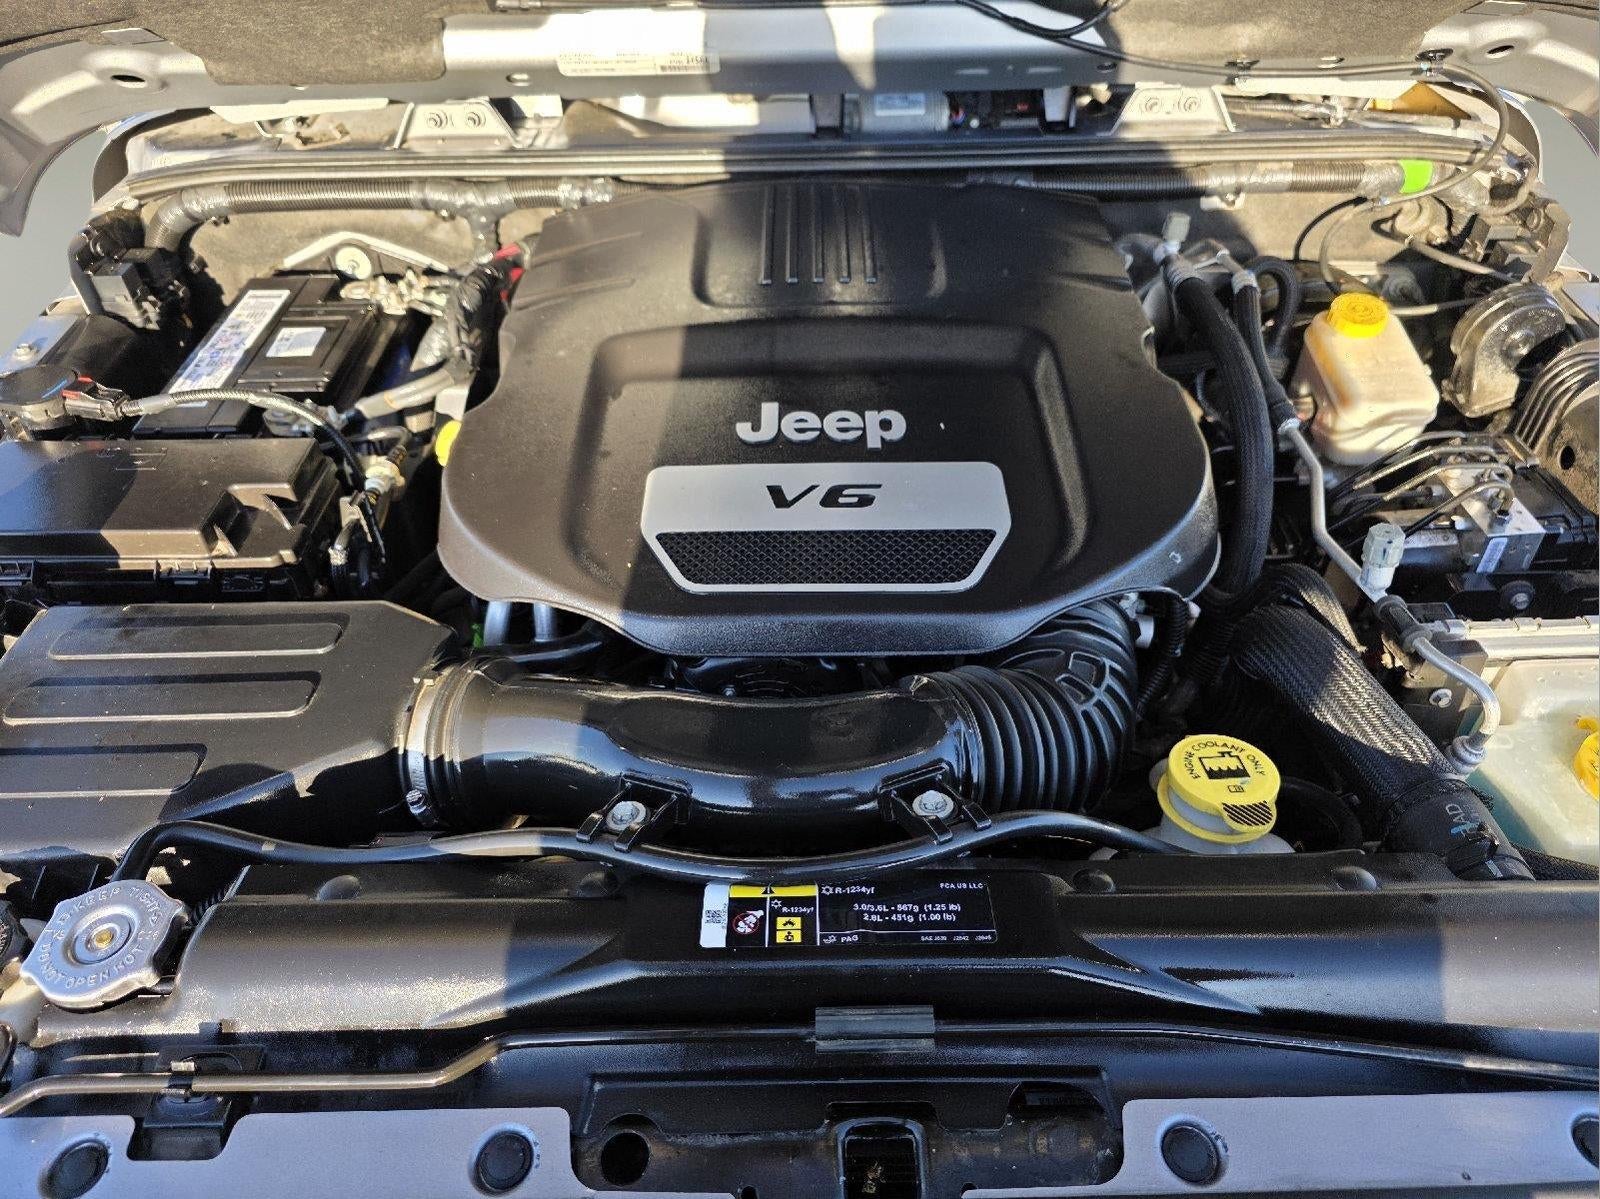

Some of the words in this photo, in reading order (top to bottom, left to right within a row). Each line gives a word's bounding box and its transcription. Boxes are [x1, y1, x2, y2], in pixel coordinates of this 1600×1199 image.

[735, 401, 907, 449] Jeep
[766, 484, 883, 509] V6
[1192, 740, 1245, 754] COOLANT
[1184, 751, 1201, 779] ENGINE
[1246, 753, 1266, 776] ONLY
[834, 885, 875, 895] R-1234yf
[852, 903, 889, 912] 3.0/3.6L
[896, 903, 920, 913] 567g
[923, 903, 947, 912] (1.25
[948, 903, 961, 912] lb)
[862, 912, 883, 922] 2.8L
[891, 913, 914, 923] 451g
[918, 913, 941, 922] (1.00
[942, 912, 956, 922] lb)
[841, 934, 859, 943] PAG
